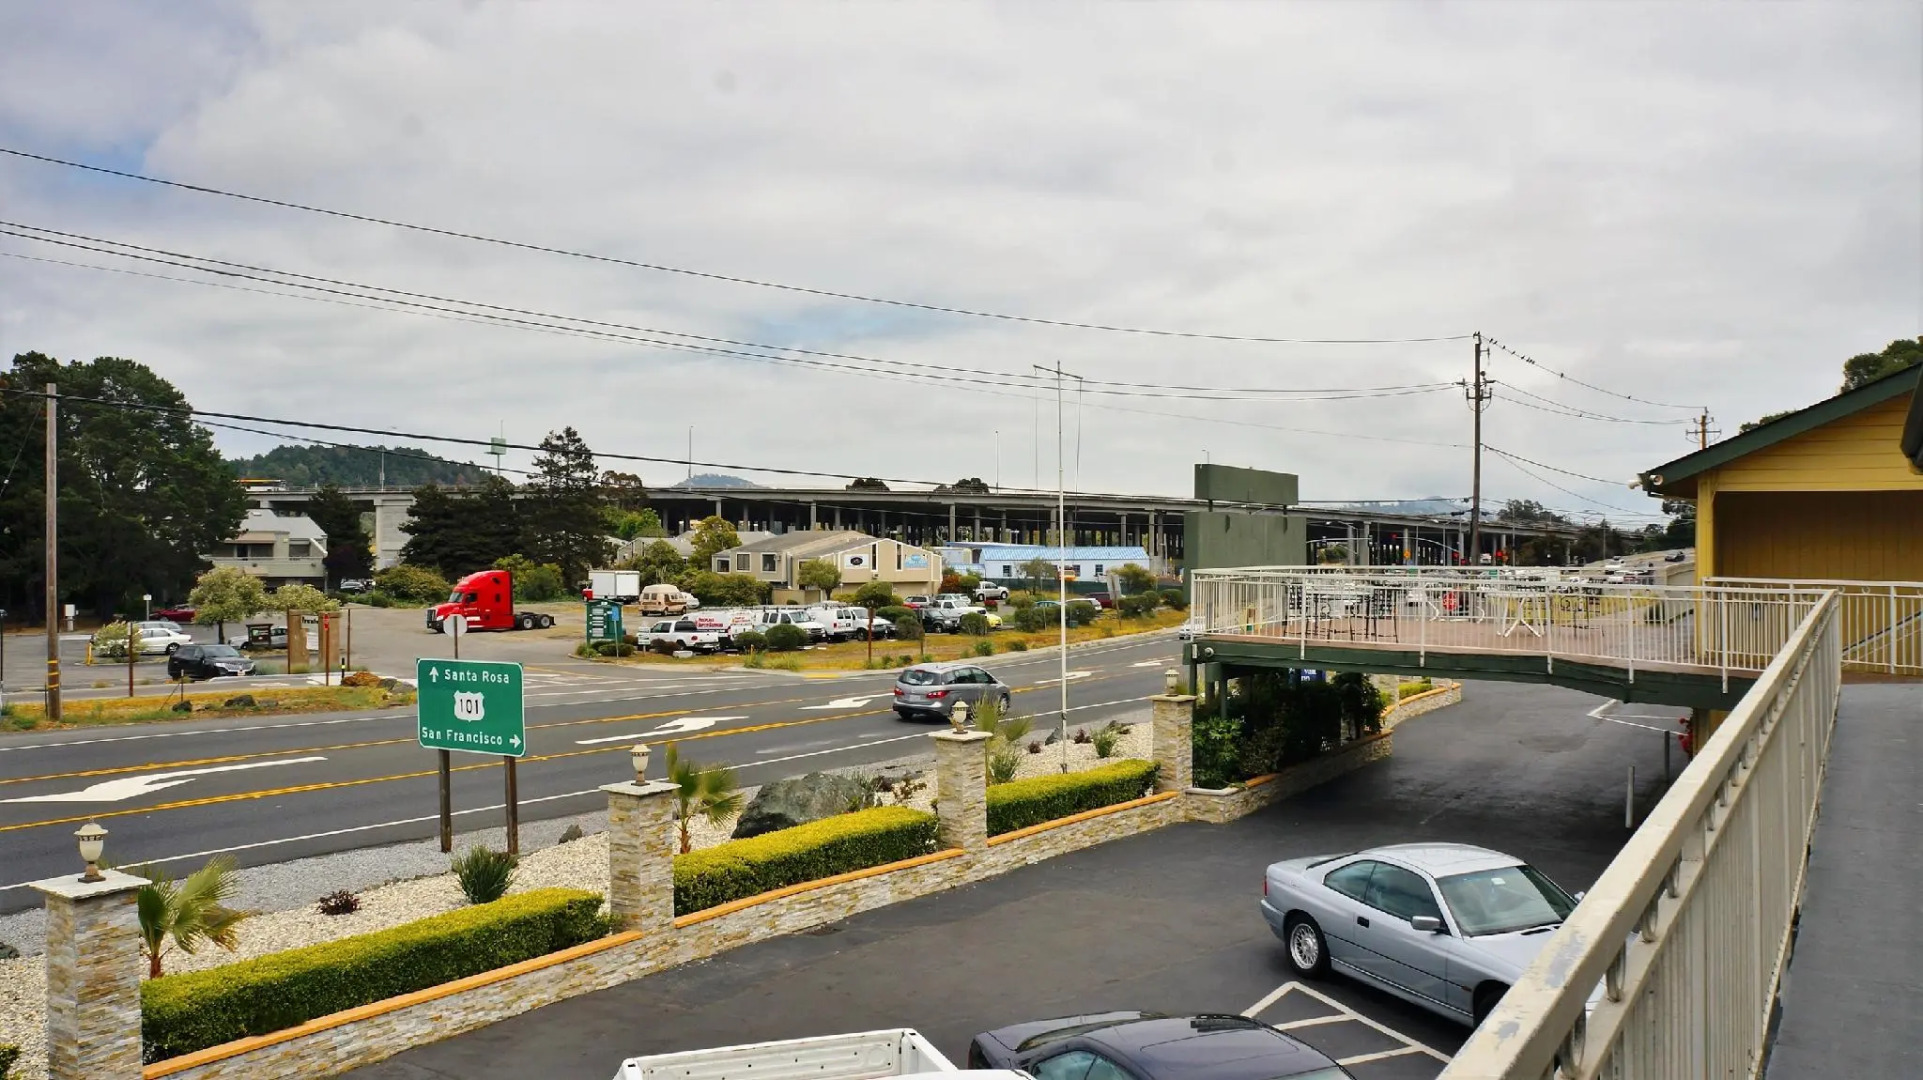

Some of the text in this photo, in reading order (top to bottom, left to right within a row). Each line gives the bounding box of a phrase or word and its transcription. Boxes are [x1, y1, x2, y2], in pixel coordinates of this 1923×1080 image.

[444, 669, 510, 684] Santa Rosa
[460, 698, 479, 715] 101
[422, 727, 503, 745] San Francisco
